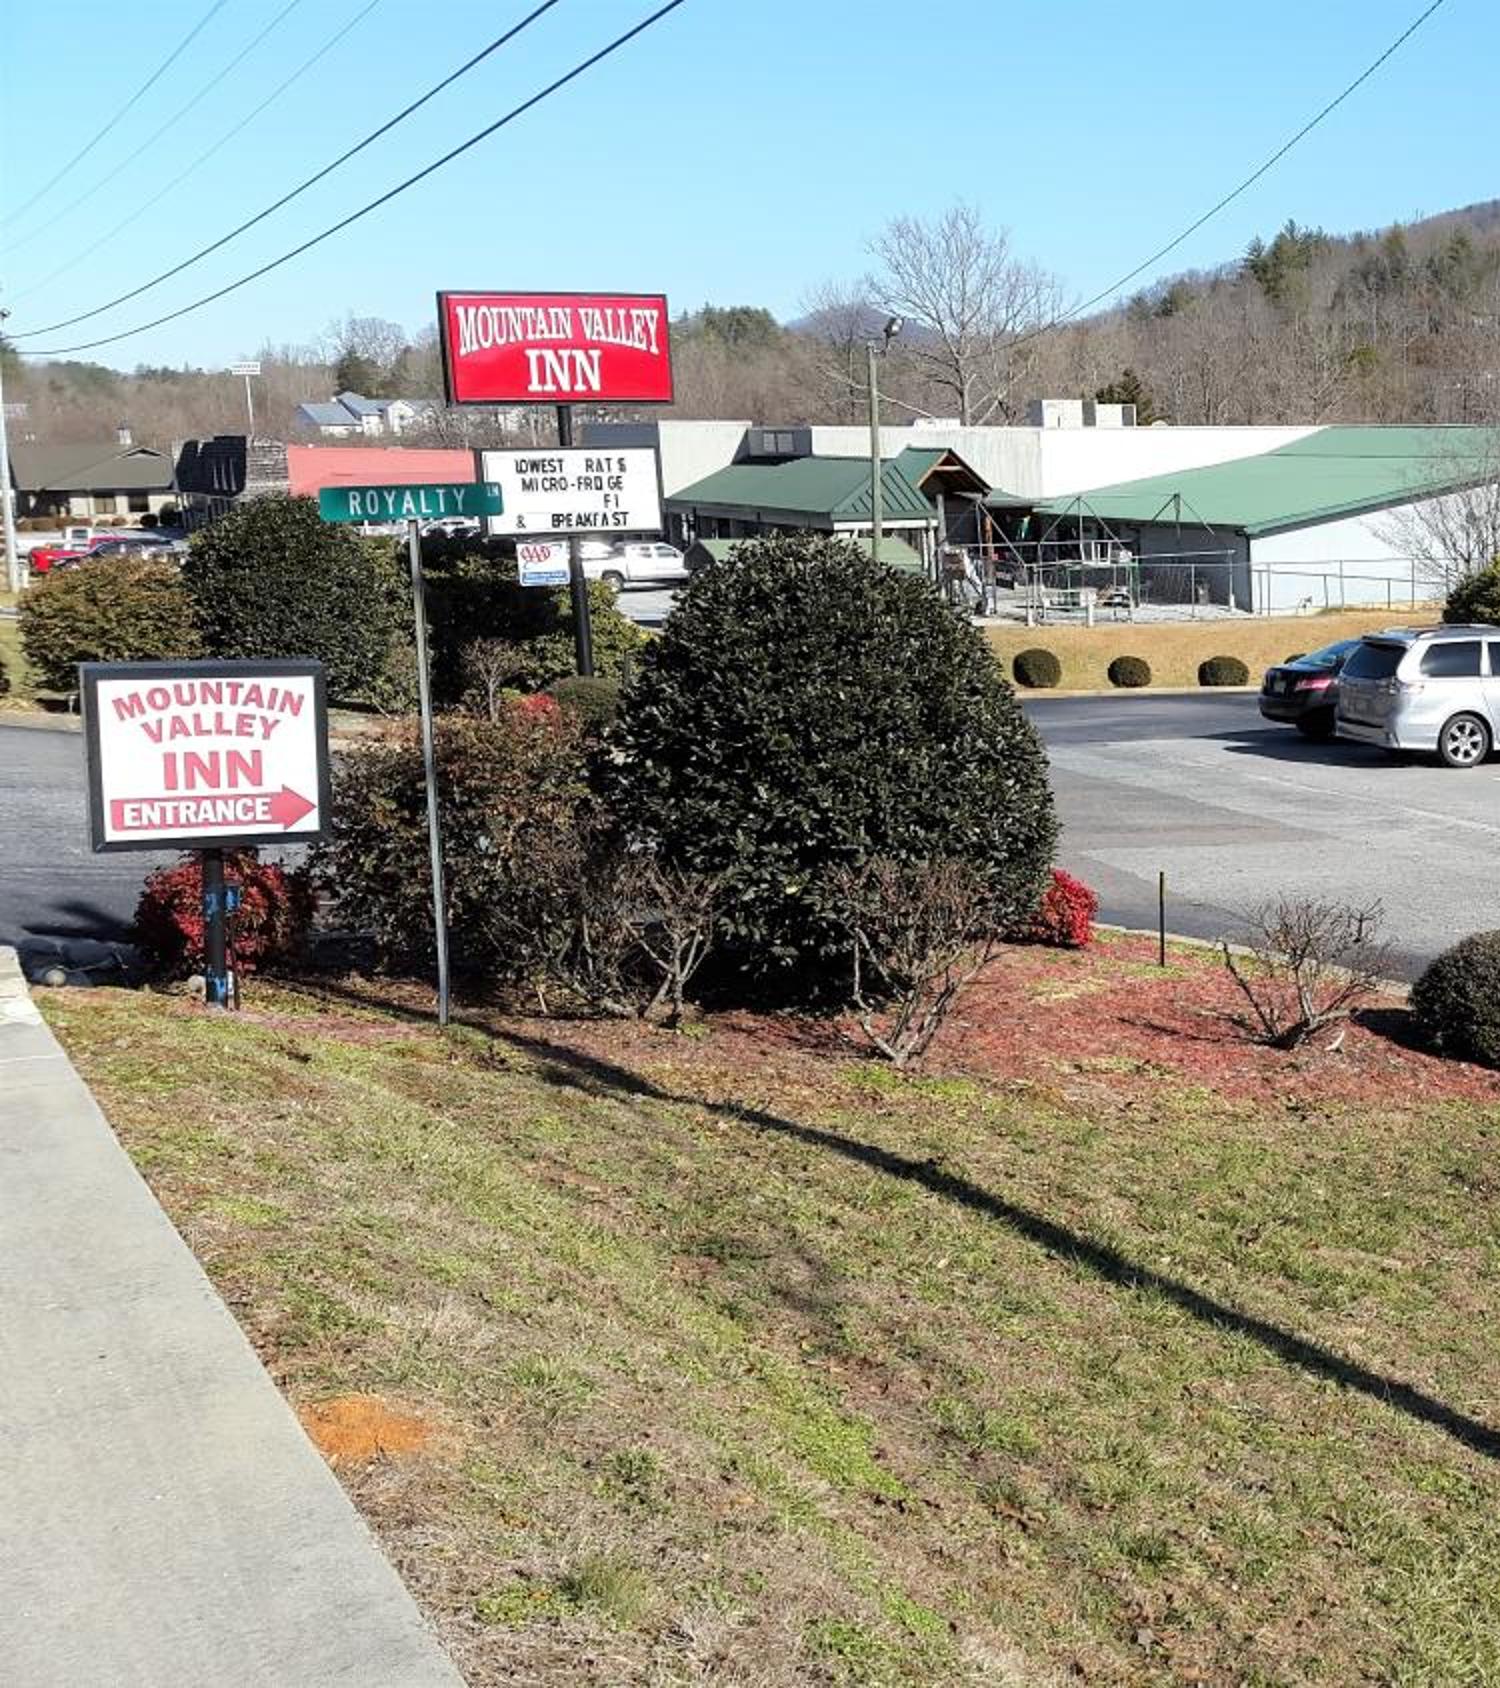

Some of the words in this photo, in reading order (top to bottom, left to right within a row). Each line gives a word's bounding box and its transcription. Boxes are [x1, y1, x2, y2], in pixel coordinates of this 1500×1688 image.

[455, 305, 572, 357] MOUNTAIN
[577, 307, 660, 355] VALLEY
[525, 349, 602, 392] INN
[514, 457, 564, 474] LOWEST
[348, 488, 465, 516] ROYALTY
[516, 514, 527, 529] &
[111, 681, 305, 722] MOUNTAIN
[140, 712, 281, 744] VALLEY
[163, 749, 264, 791] INN
[123, 797, 272, 828] ENTRANCE
